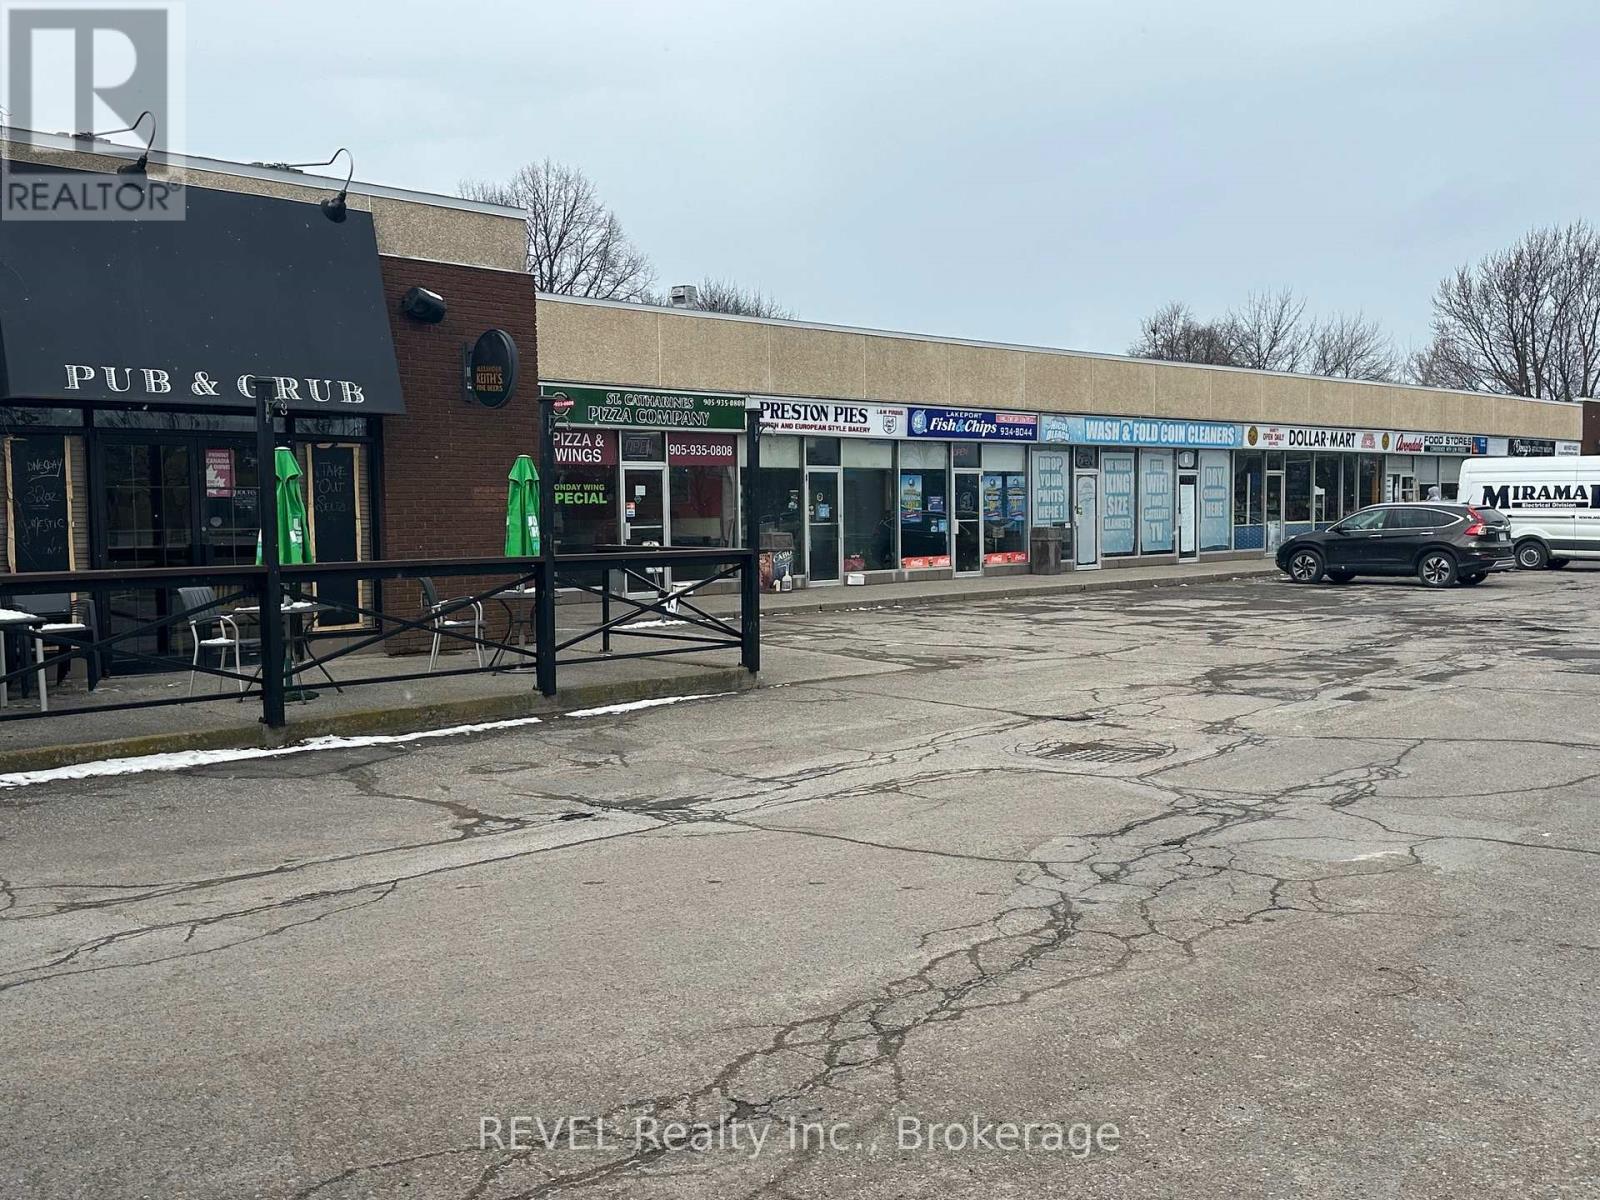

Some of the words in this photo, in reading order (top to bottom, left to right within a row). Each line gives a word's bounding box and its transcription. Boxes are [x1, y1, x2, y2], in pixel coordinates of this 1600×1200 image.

[64, 364, 172, 393] PUB
[190, 371, 220, 396] &
[237, 374, 366, 404] GRUB
[476, 373, 503, 384] KEITH'S
[606, 392, 622, 405] ST.
[624, 393, 694, 409] CATHARINES
[588, 406, 632, 422] PIZZA
[636, 408, 710, 426] COMPANY
[759, 401, 829, 421] PRESTON
[834, 406, 868, 424] PIES
[946, 411, 982, 419] LAKEPORT
[795, 423, 827, 431] EUROPEAN
[828, 424, 847, 432] STYLE
[848, 425, 871, 433] BAKERY
[1086, 420, 1120, 440] WASH
[1122, 422, 1131, 441] &
[1133, 422, 1158, 442] FOLD
[1160, 423, 1186, 443] COIN
[1188, 424, 1235, 445] CLEANERS
[553, 432, 591, 446] PIZZA
[595, 433, 604, 447] &
[1424, 435, 1443, 444] FOOD
[1446, 437, 1471, 446] STORES
[555, 448, 602, 462] WINGS
[669, 444, 733, 456] 905-935-0808
[1040, 457, 1061, 470] DROP
[1040, 473, 1063, 487] YOUR
[1106, 473, 1130, 494] KING
[1146, 473, 1168, 494] WIFI
[1206, 468, 1224, 486] DRY
[555, 492, 608, 504] PECIAL
[1107, 495, 1129, 515] SIZE
[1205, 501, 1224, 517] HERE
[1151, 522, 1163, 541] TV
